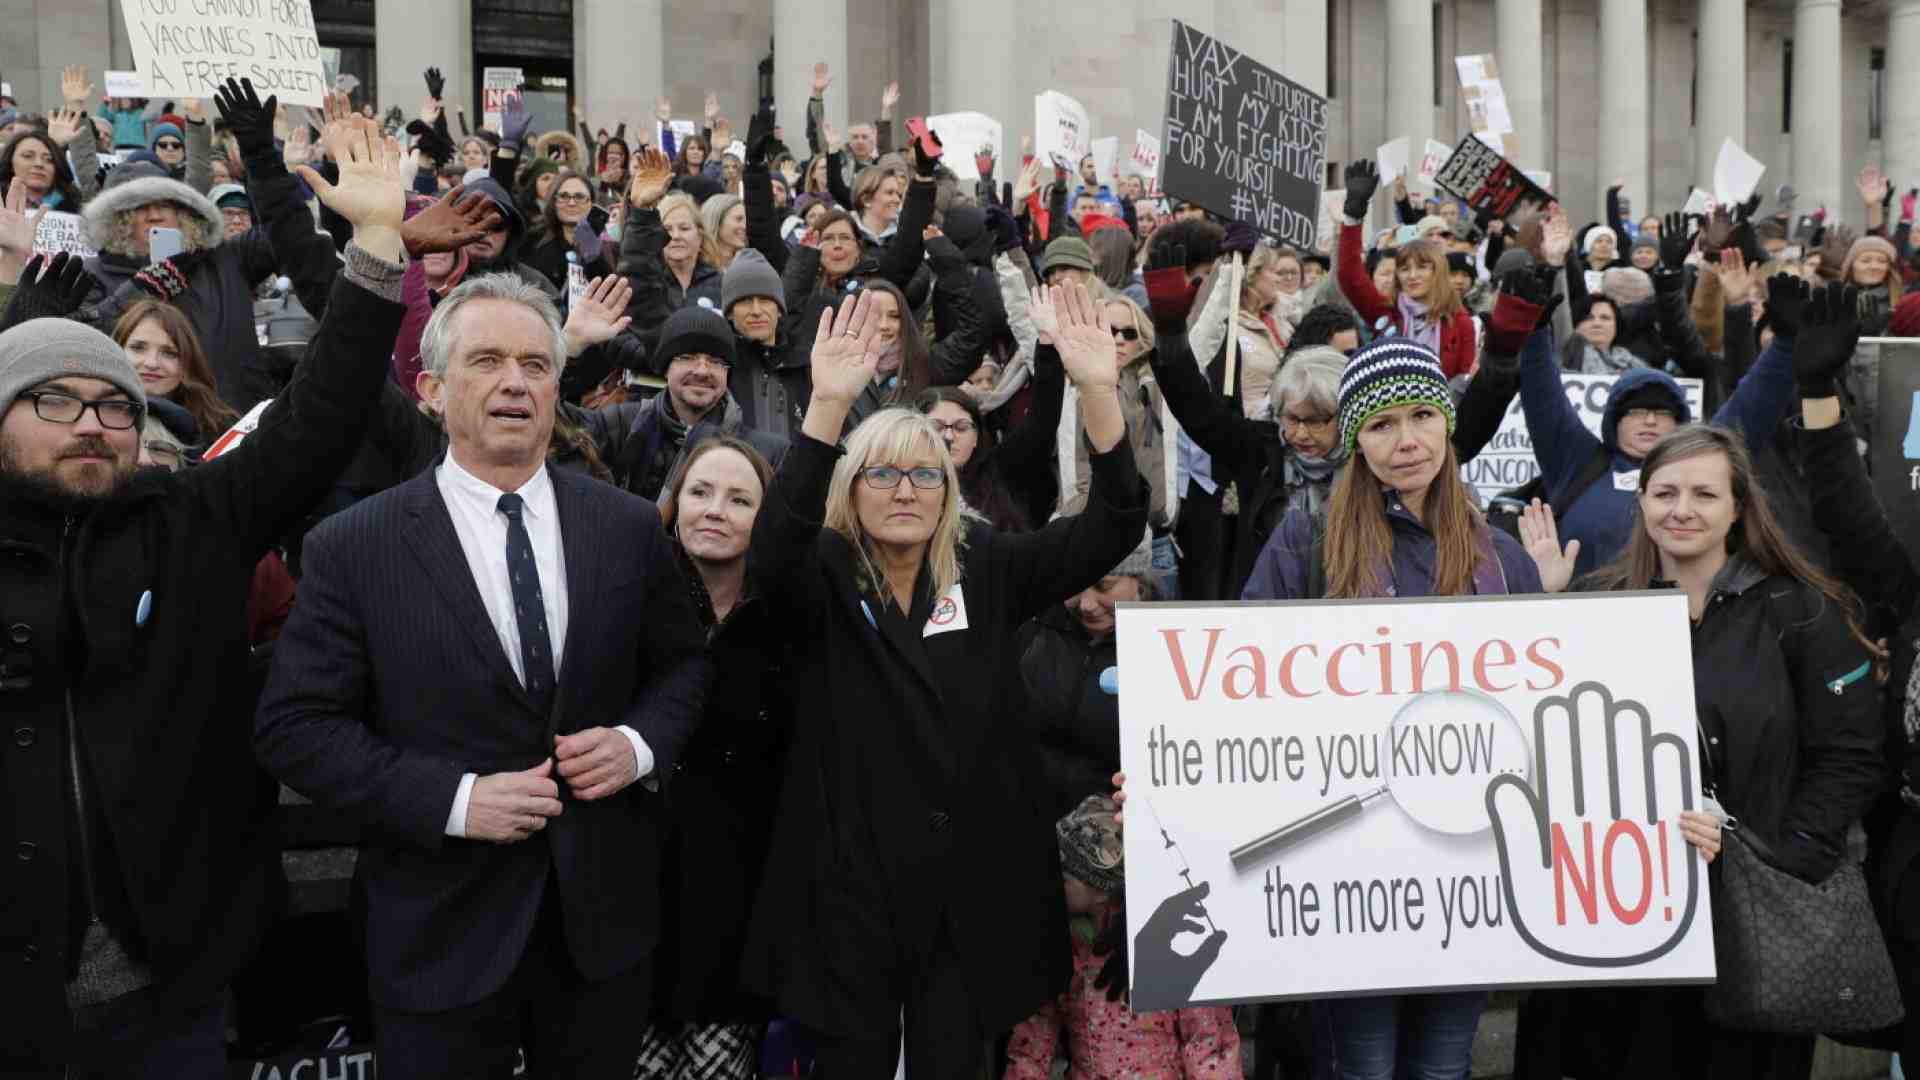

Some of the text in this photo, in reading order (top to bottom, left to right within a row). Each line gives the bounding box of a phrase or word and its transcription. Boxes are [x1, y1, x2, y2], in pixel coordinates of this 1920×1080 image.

[140, 20, 320, 60] VACCINES INTO
[152, 61, 174, 90] A
[1174, 55, 1326, 158] HURT MY KIDS
[1252, 69, 1329, 130] INJURIES
[1166, 124, 1206, 169] FOR
[1214, 142, 1274, 199] YOURS!!
[1168, 91, 1323, 184] I AM FIGHTING
[1231, 188, 1313, 249] #WEDID
[1157, 626, 1565, 701] Vaccines
[1148, 724, 1203, 787] the
[1216, 735, 1304, 785] more
[1316, 733, 1379, 797] you
[1264, 819, 1674, 949] the more you NO!
